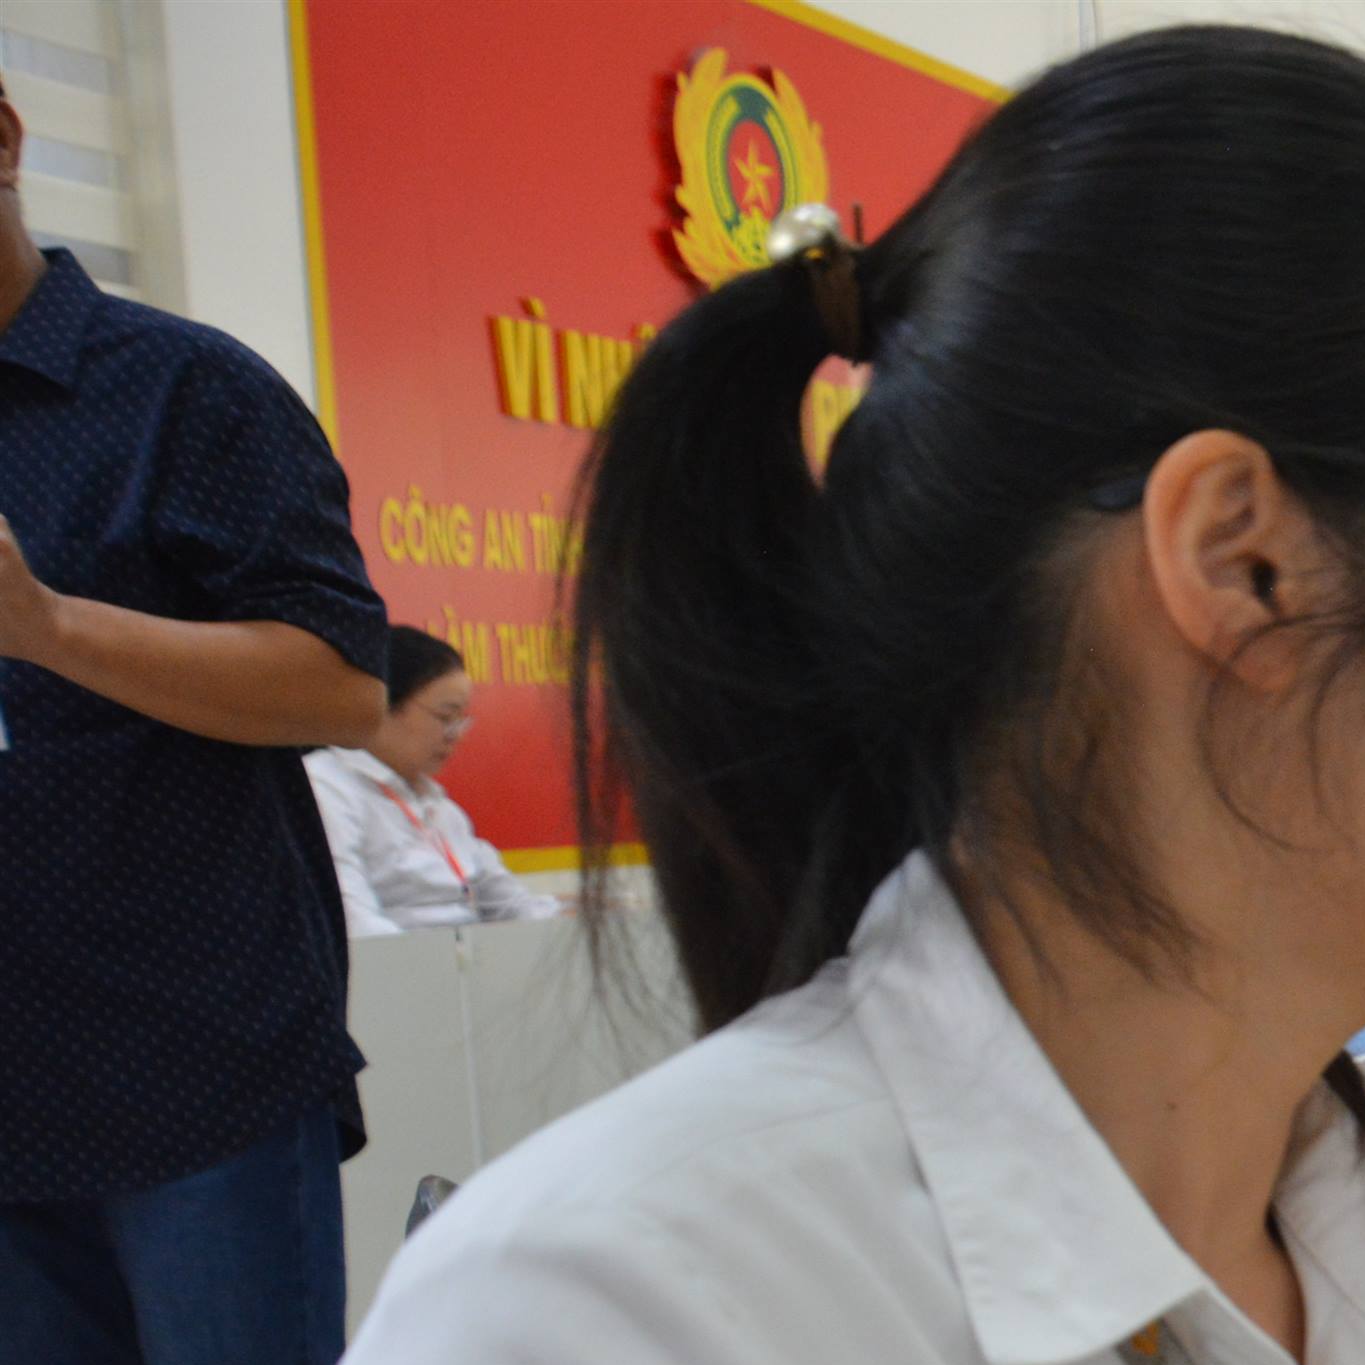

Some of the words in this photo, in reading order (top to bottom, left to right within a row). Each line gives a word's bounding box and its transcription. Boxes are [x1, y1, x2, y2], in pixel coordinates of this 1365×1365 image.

[492, 297, 557, 424] VÌ
[379, 484, 475, 568] CÔNG
[484, 508, 527, 573] AN
